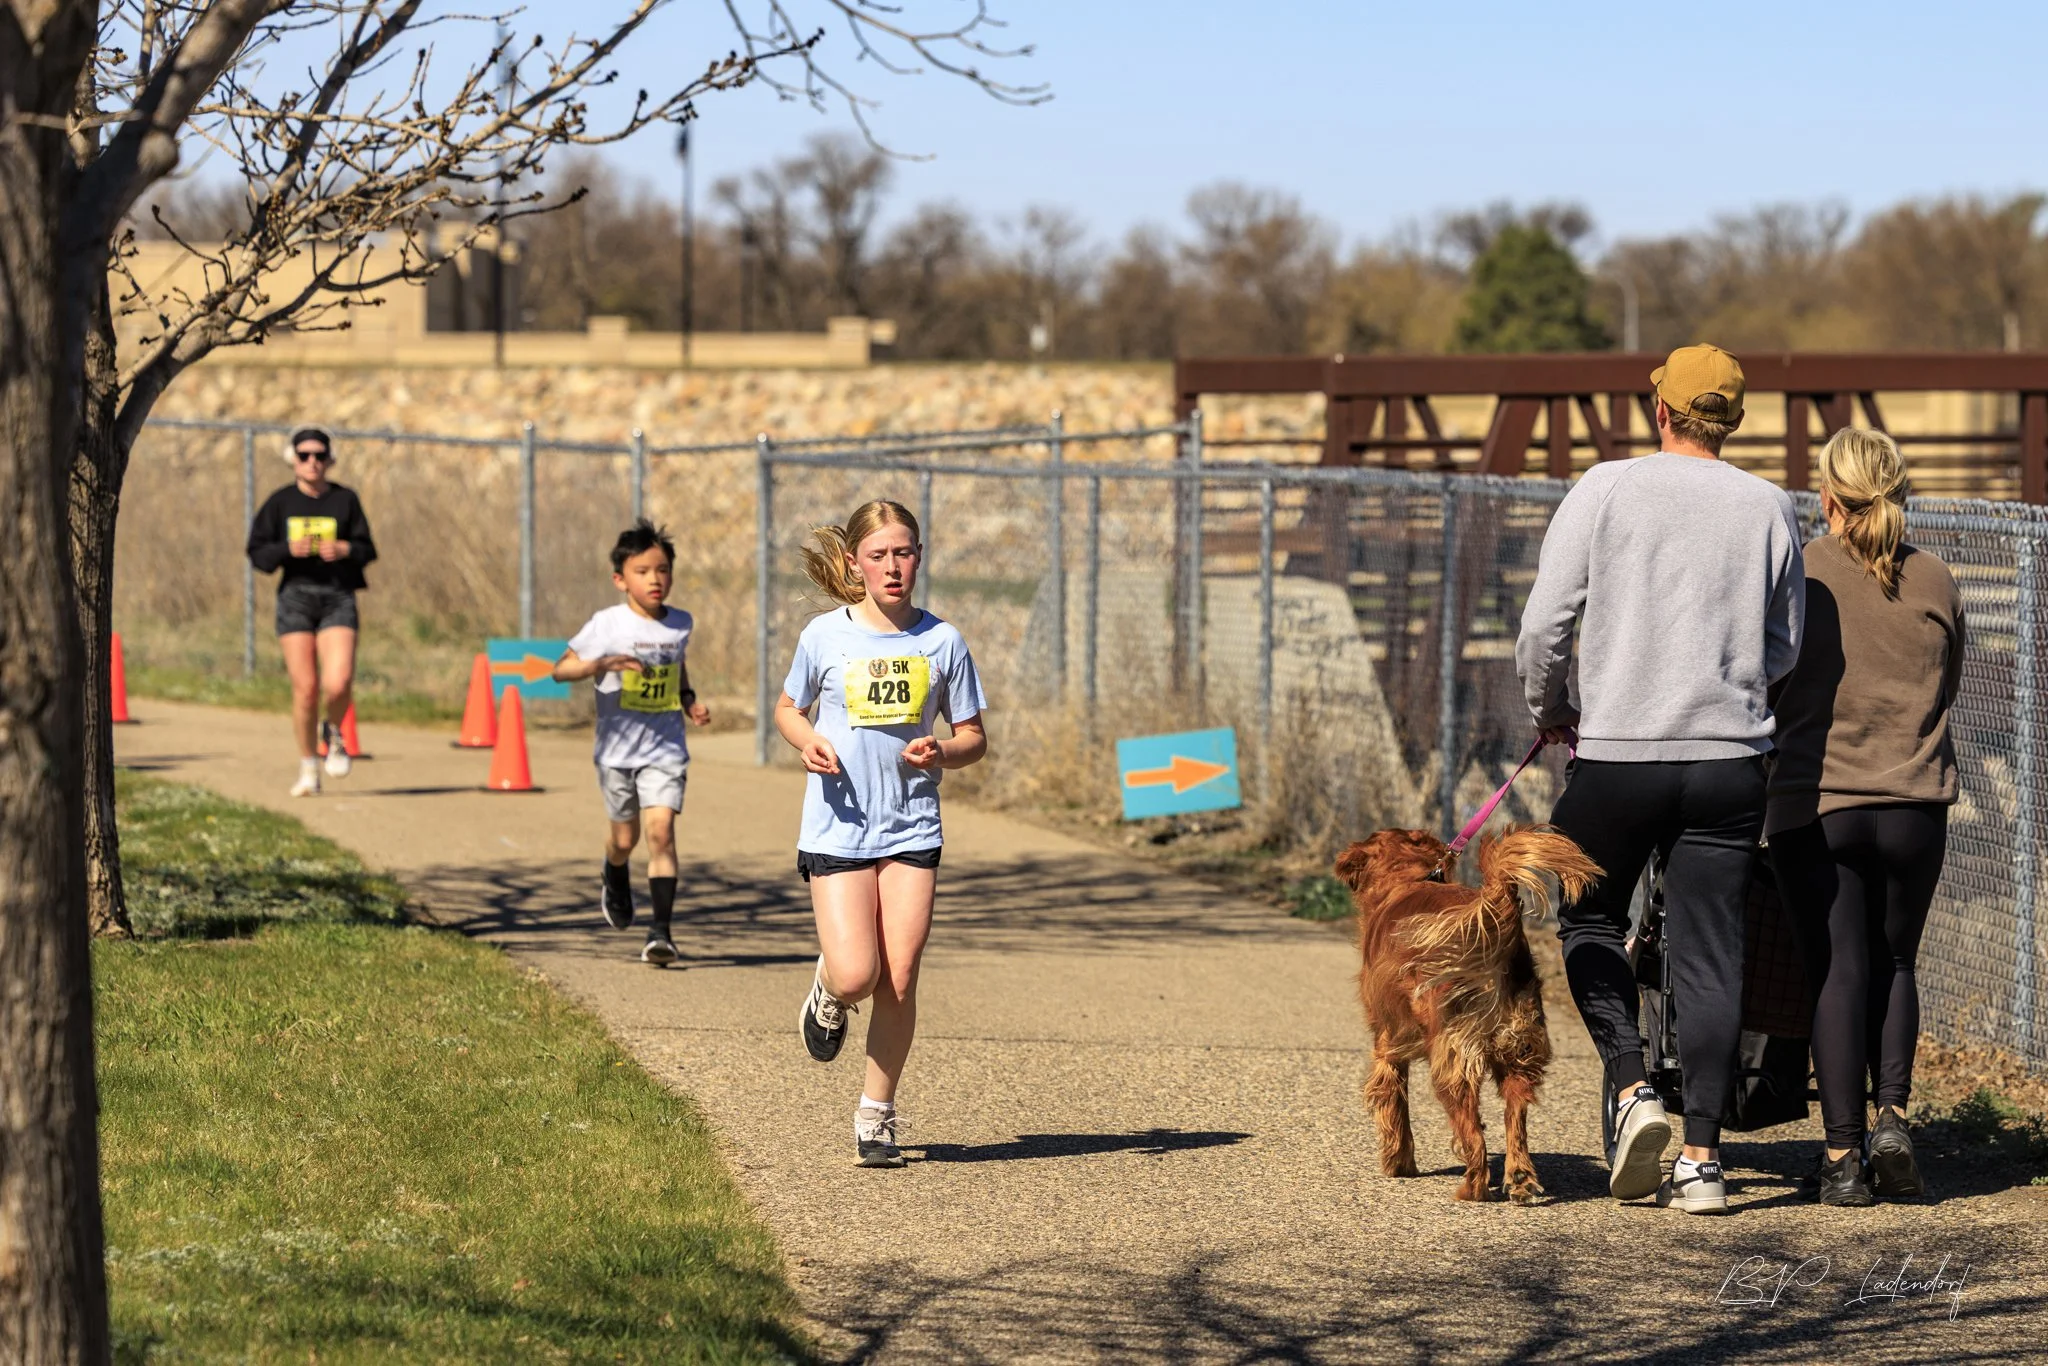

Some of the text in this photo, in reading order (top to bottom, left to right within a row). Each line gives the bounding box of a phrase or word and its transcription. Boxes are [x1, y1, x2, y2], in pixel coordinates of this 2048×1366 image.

[892, 660, 910, 674] 5K
[641, 682, 666, 699] 211
[867, 680, 911, 705] 428
[1702, 1166, 1718, 1174] NIKE
